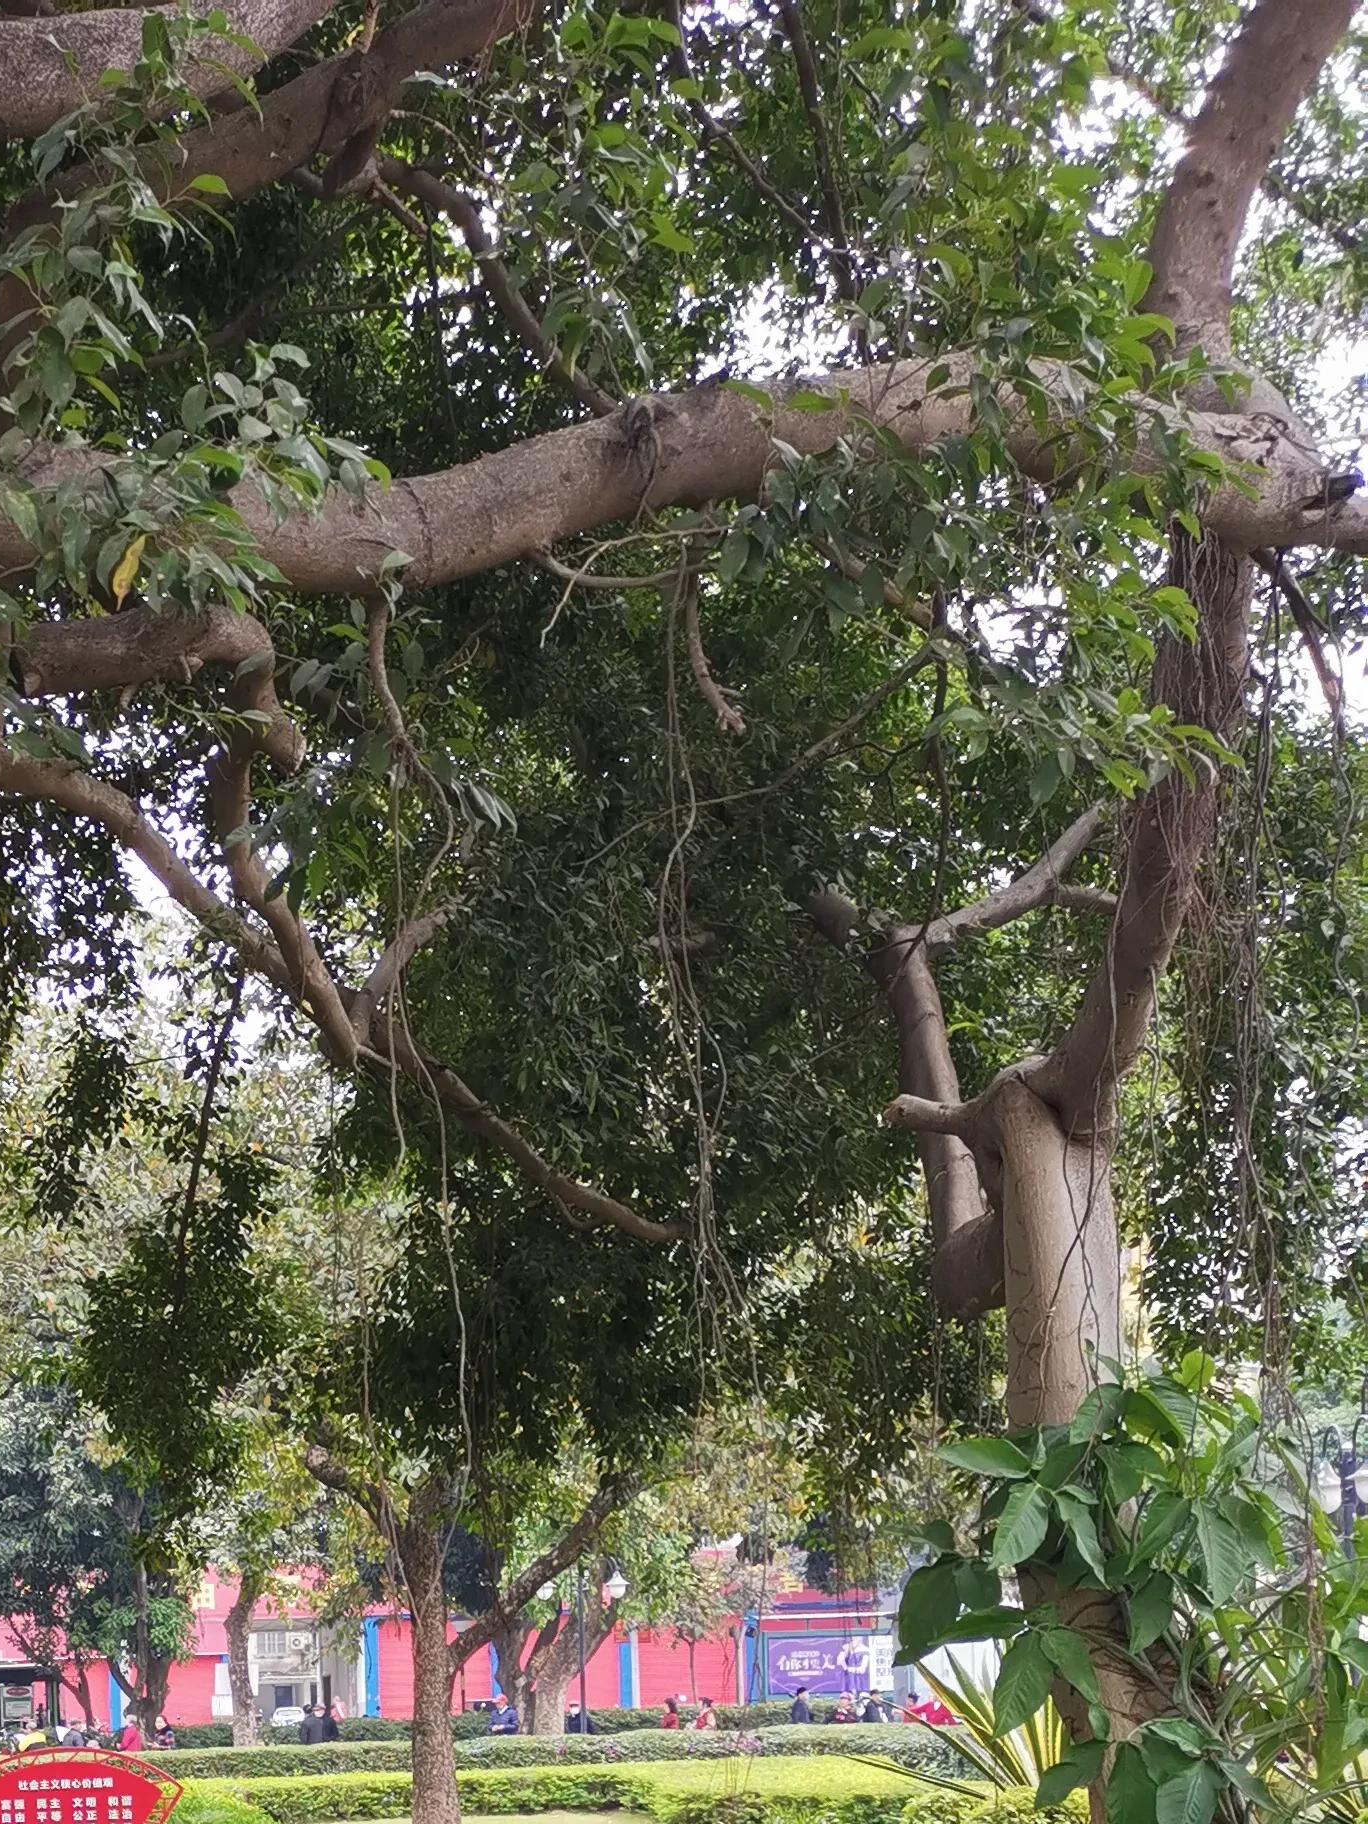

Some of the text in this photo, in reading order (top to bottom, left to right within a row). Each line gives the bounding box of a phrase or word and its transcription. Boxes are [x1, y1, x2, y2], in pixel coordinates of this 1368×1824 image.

[18, 1778, 113, 1791] 社会主义核心价值观
[0, 1796, 133, 1810] 富强 民主 文明 和谐
[1, 1809, 133, 1823] 自由 平等 公正 法治
